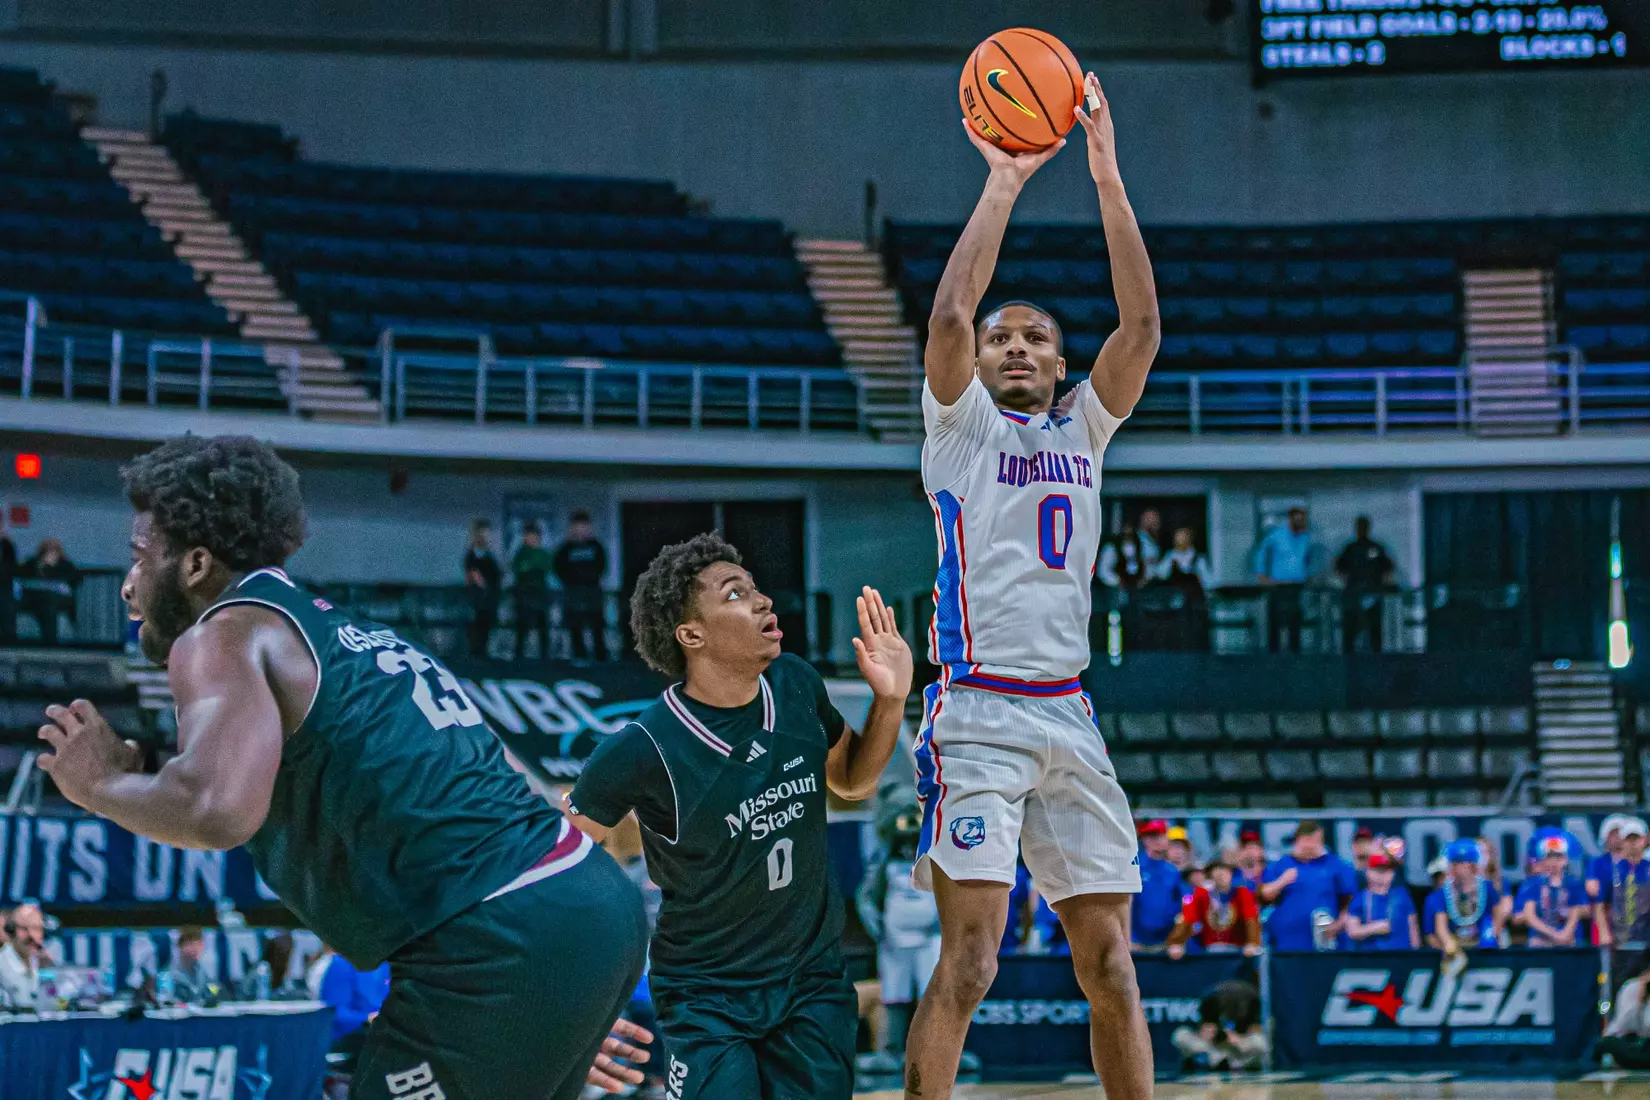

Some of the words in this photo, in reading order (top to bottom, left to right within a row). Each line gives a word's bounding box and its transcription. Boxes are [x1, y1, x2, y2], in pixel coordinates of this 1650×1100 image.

[1262, 42, 1352, 69] STEALS
[1501, 34, 1595, 60] BLOCKS
[963, 85, 1004, 143] ELITE
[1038, 494, 1074, 570] 0
[377, 648, 483, 730] 23
[725, 773, 817, 838] Missouri
[751, 801, 805, 841] State
[0, 818, 108, 902] ITS
[767, 837, 793, 891] 0
[1019, 1000, 1090, 1024] SPOR
